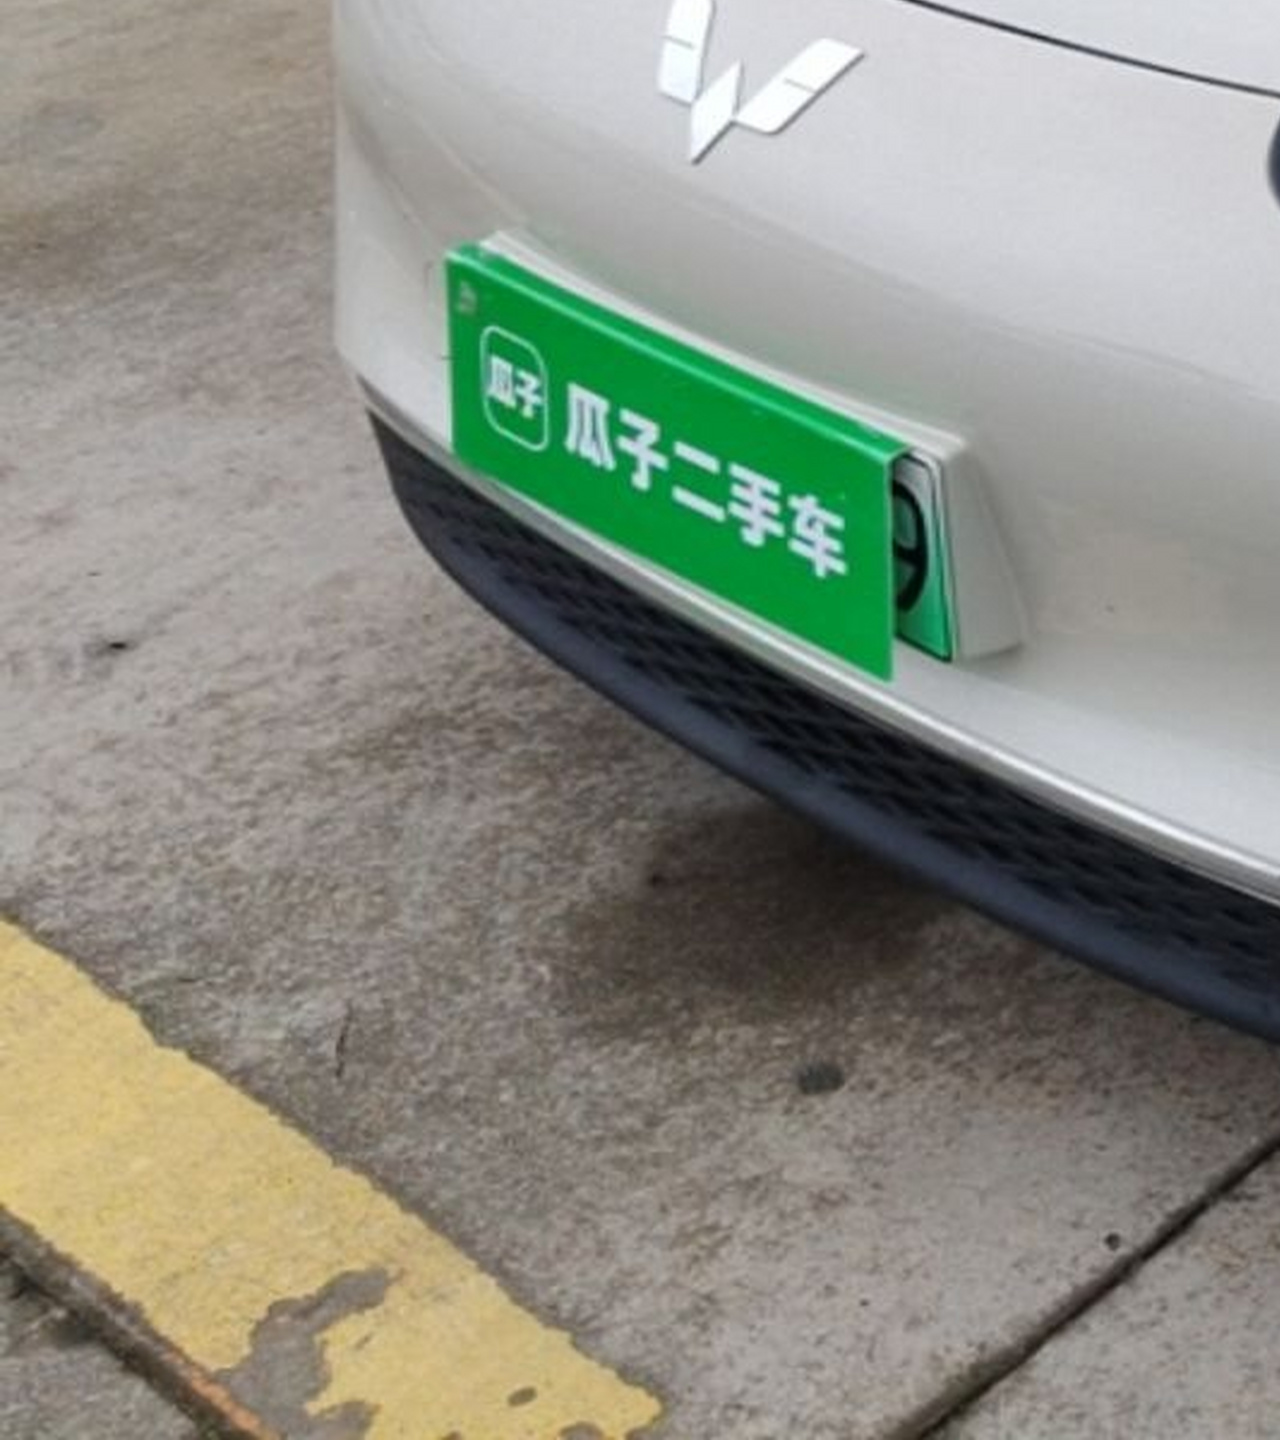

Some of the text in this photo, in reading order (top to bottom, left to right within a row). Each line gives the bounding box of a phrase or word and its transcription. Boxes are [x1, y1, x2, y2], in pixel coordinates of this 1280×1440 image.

[484, 354, 543, 420] 瓜子
[562, 381, 848, 579] 瓜子二手车
